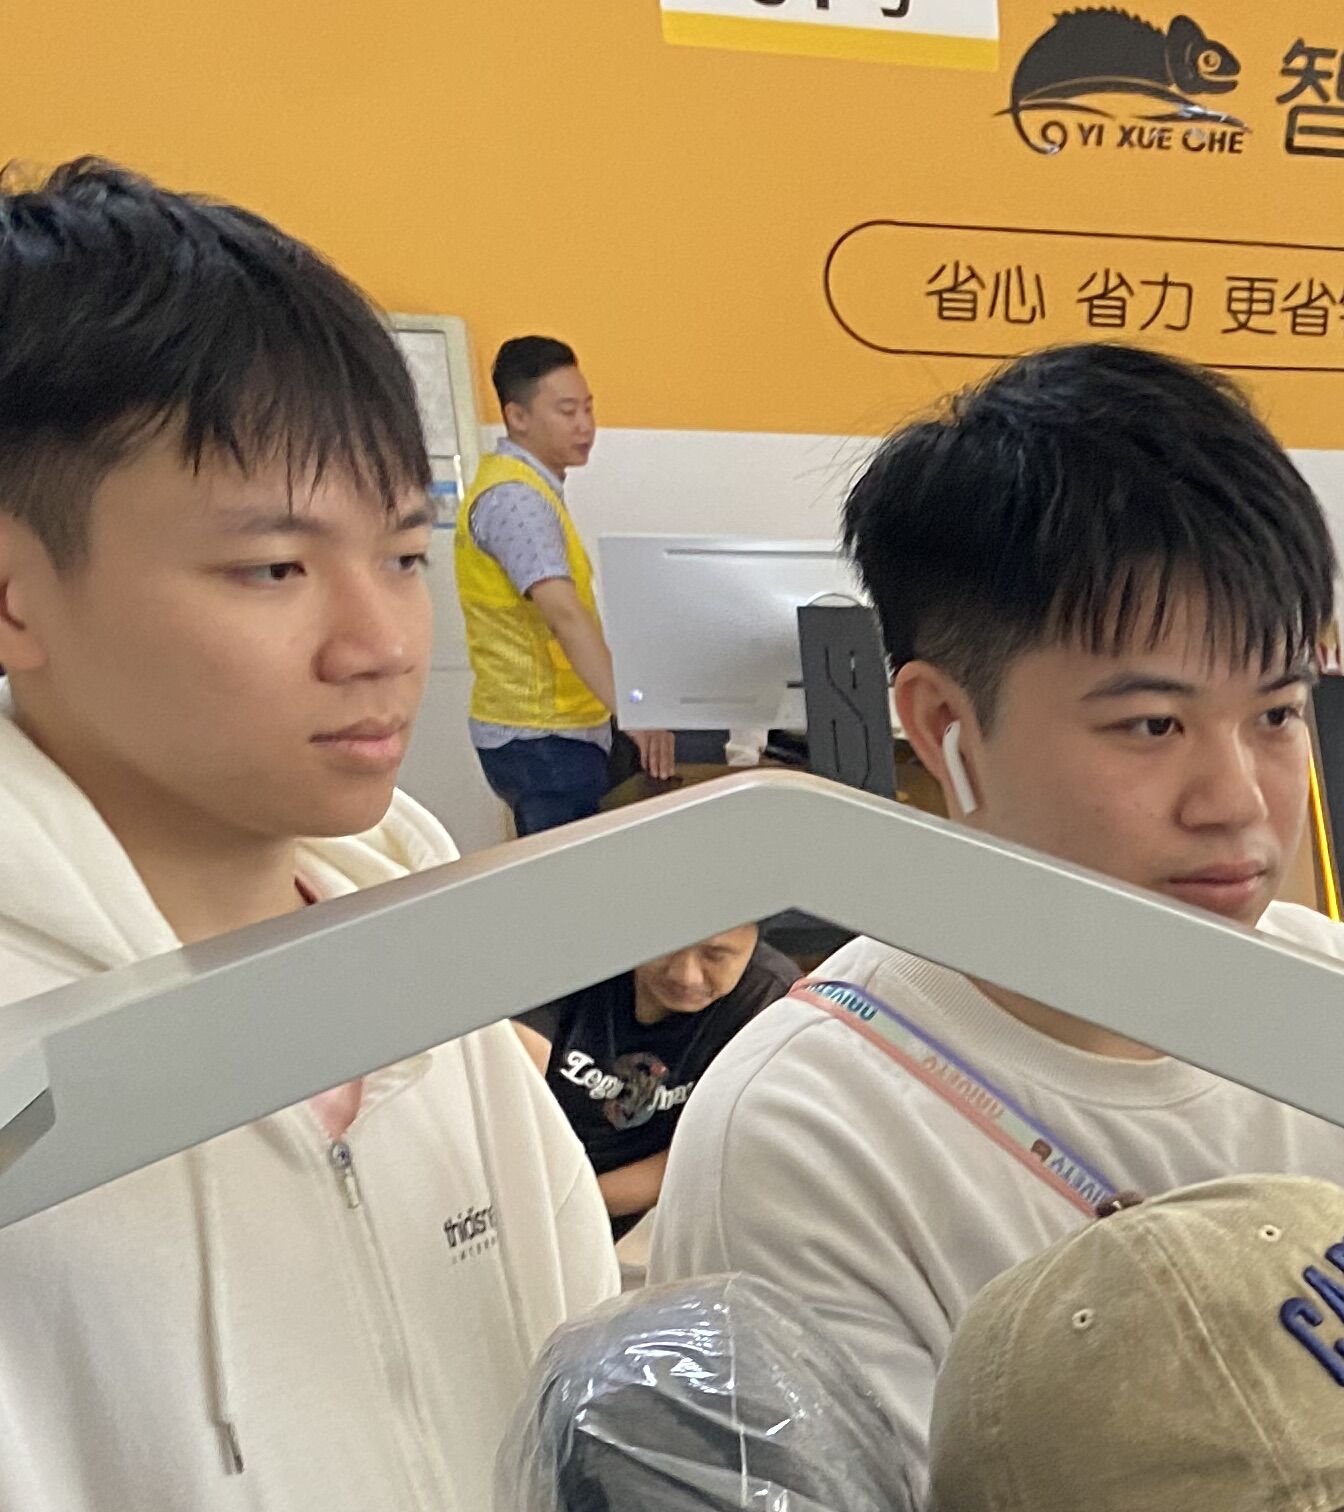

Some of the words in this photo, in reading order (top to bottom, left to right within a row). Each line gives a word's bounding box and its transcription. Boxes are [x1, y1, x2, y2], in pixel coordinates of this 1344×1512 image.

[1077, 123, 1105, 147] YI
[1116, 124, 1174, 150] XUE
[1182, 128, 1244, 154] CHE
[926, 260, 1046, 325] 省心
[1077, 268, 1193, 331] 省力
